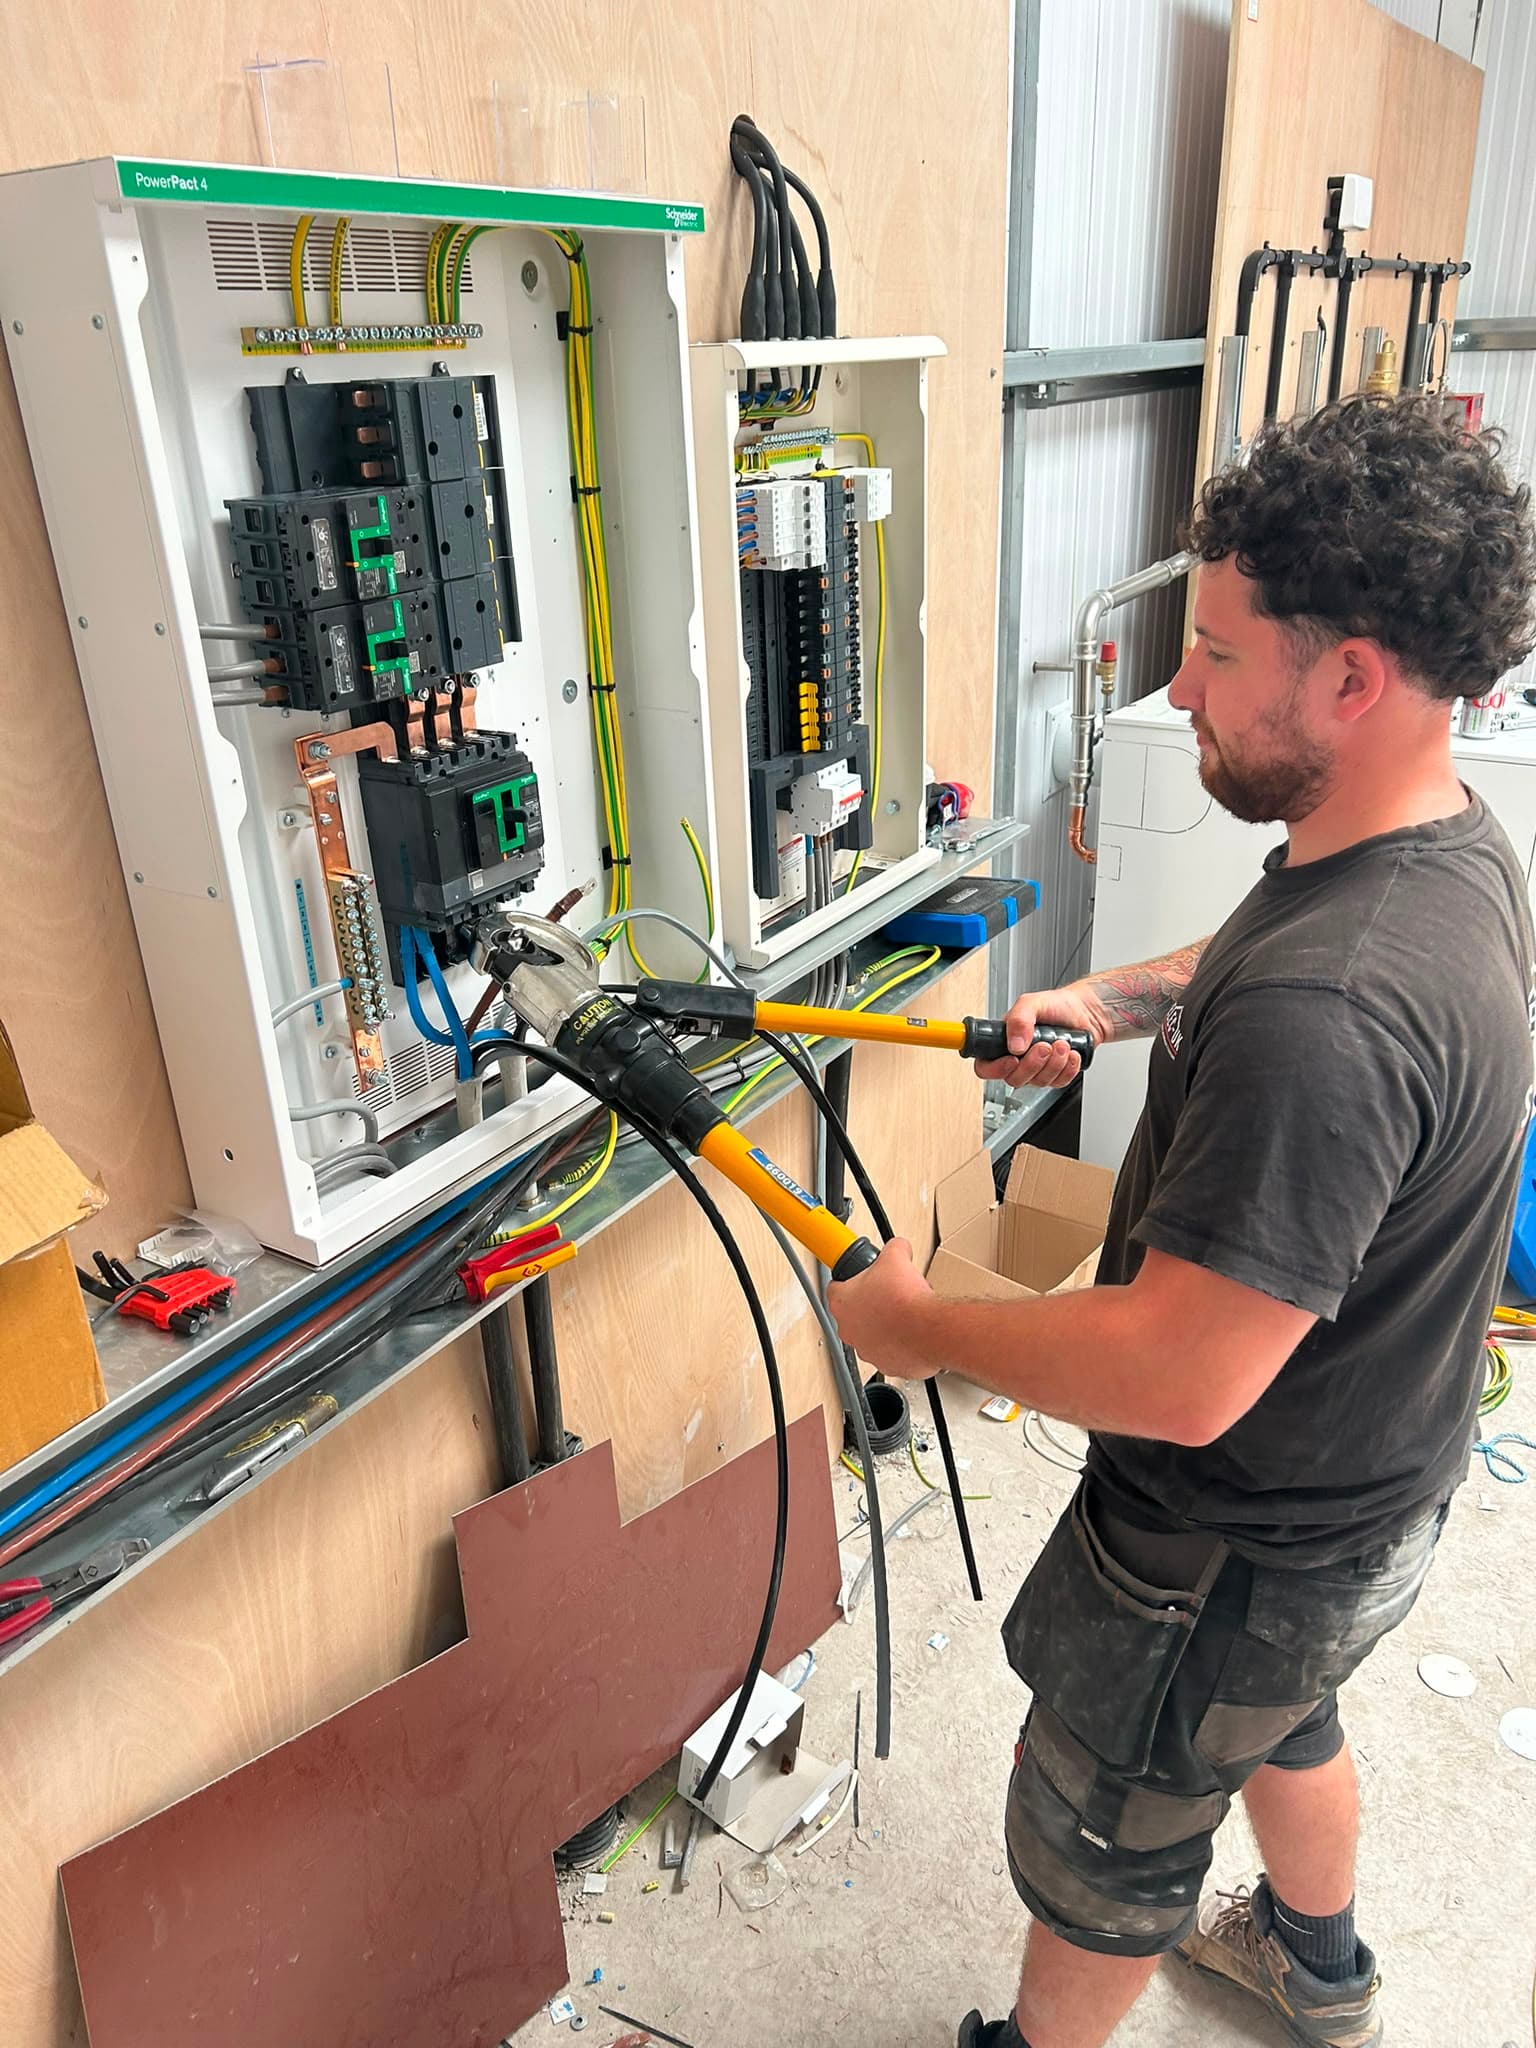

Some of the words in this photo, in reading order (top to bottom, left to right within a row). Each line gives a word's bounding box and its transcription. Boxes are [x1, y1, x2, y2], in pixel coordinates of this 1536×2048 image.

[135, 171, 200, 191] PowerPact
[200, 177, 208, 191] 4
[665, 207, 698, 228] Schneider
[573, 998, 613, 1031] CAUTION
[765, 1162, 803, 1195] 660019
